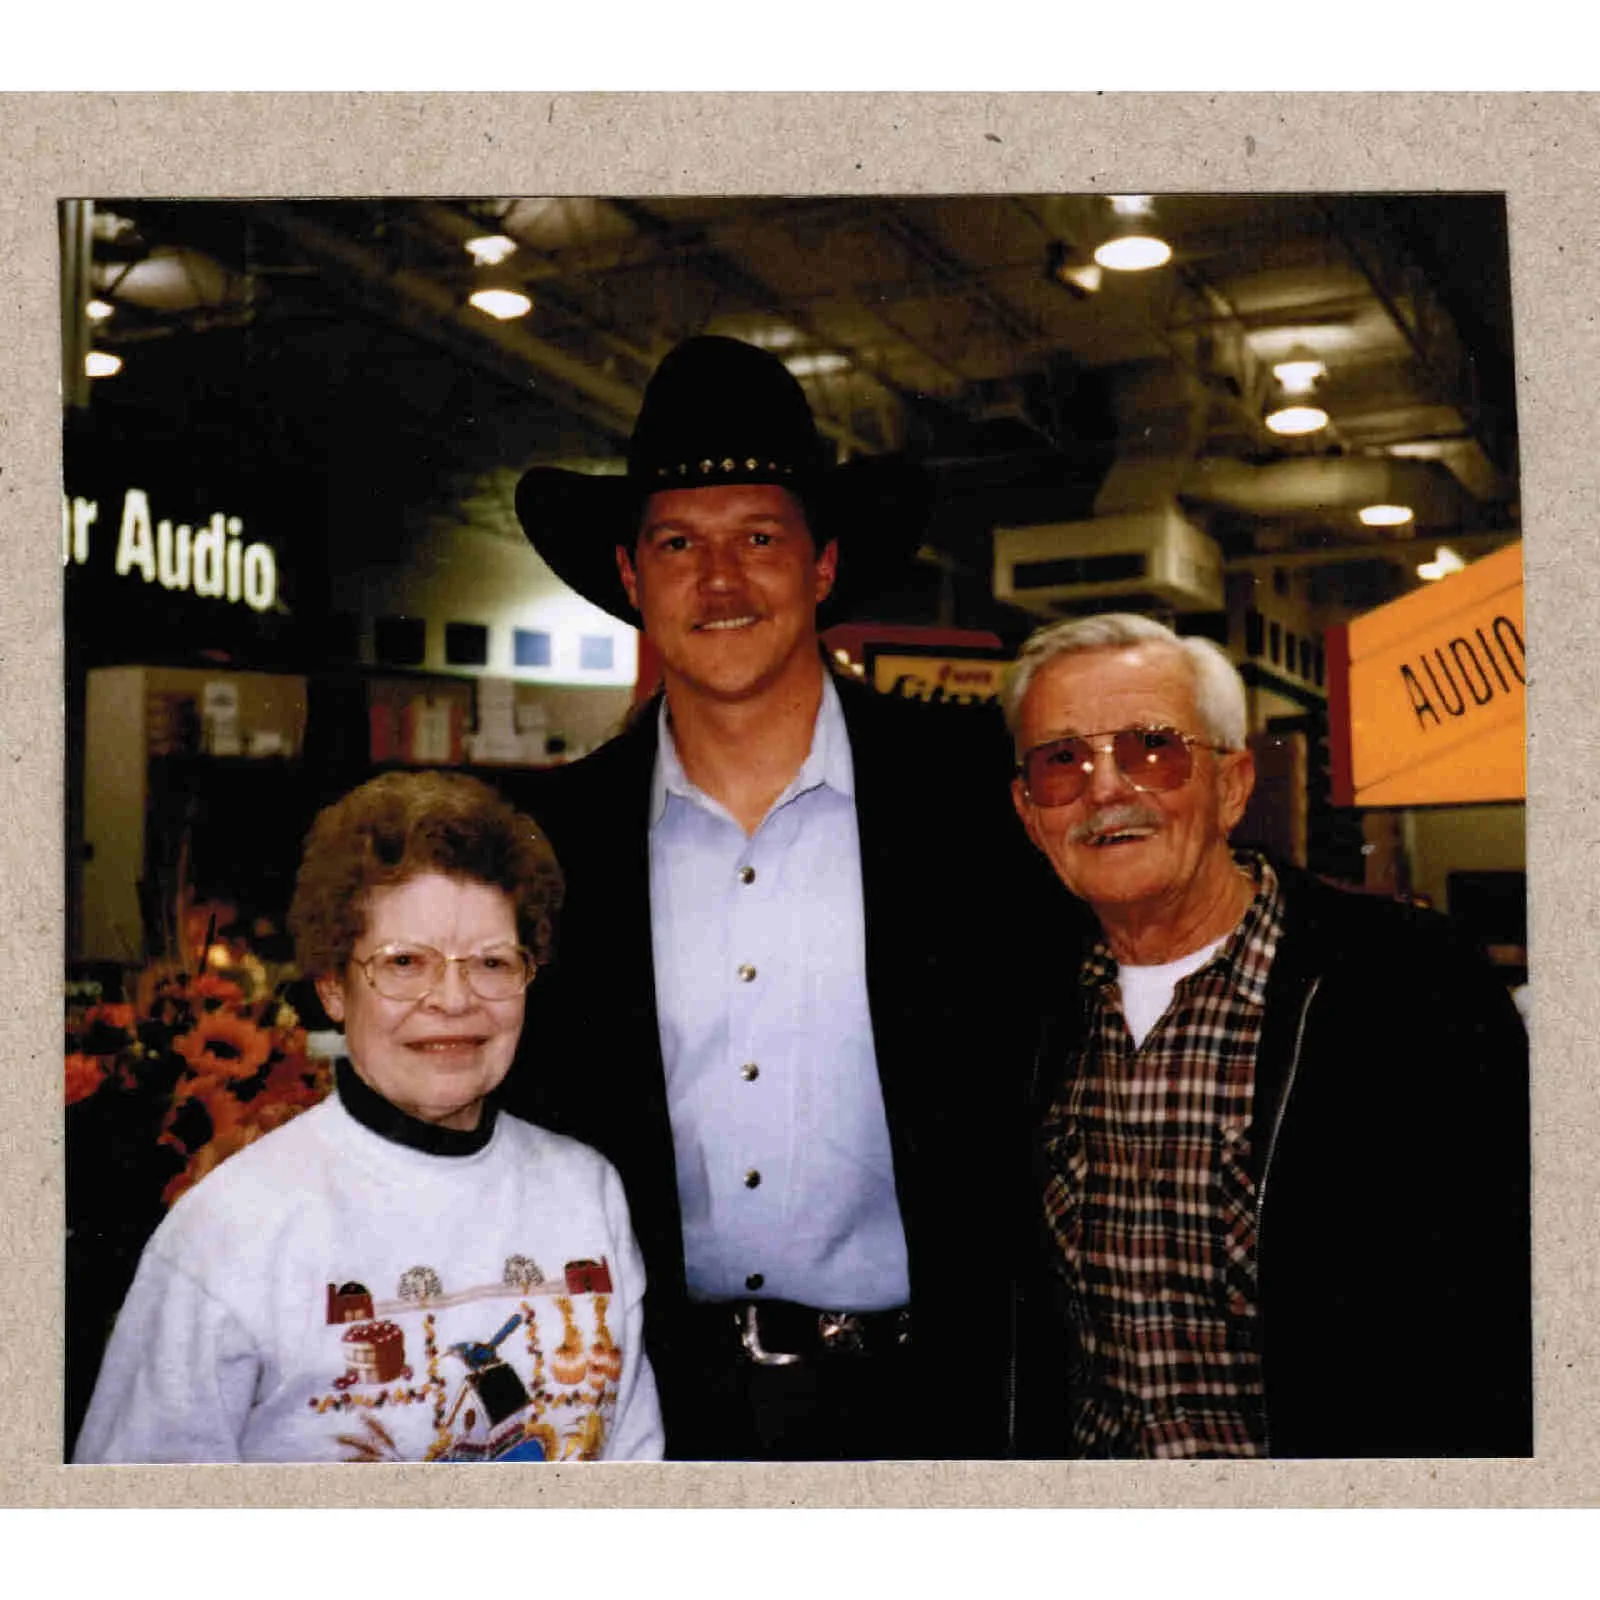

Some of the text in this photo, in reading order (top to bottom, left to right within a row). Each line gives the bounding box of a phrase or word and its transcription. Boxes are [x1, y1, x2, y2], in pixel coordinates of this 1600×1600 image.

[63, 488, 277, 612] r Audio
[1400, 615, 1526, 732] AUDIO
